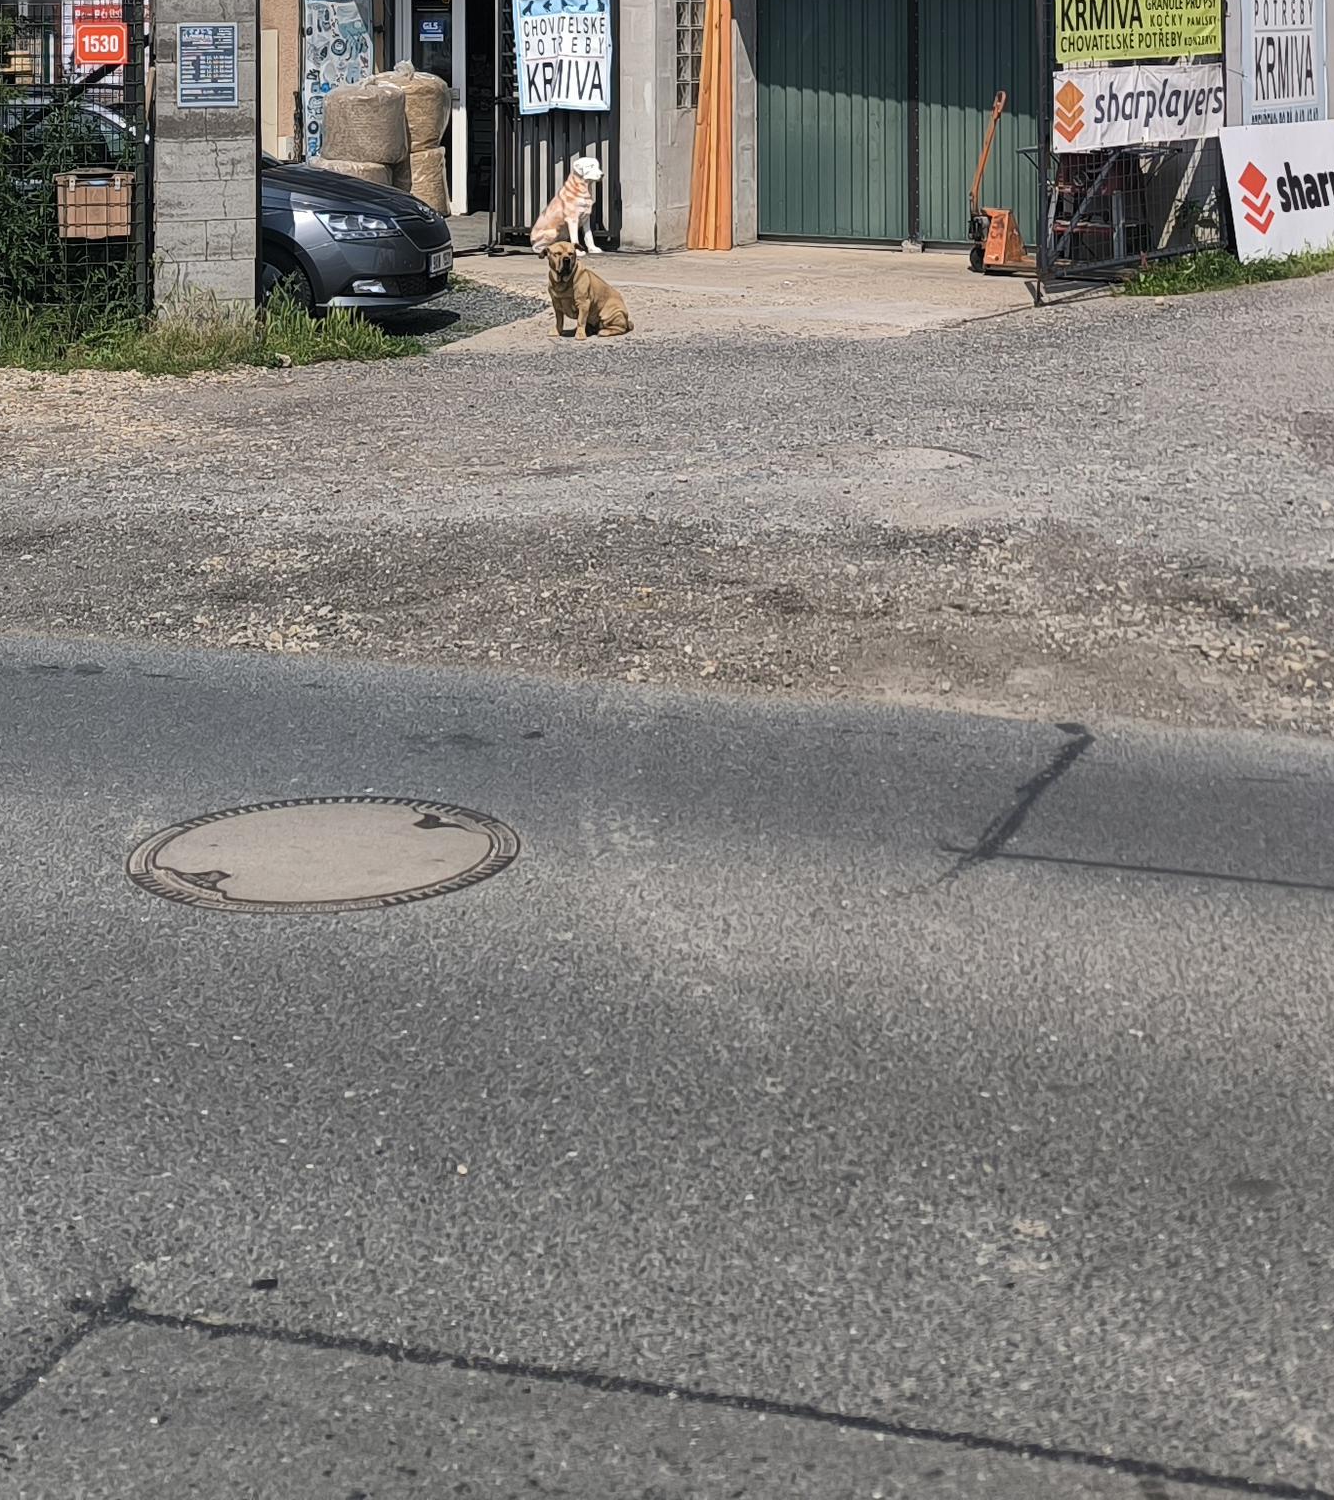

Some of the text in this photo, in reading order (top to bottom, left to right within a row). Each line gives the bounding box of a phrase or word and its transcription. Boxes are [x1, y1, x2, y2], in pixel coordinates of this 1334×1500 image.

[1149, 12, 1217, 27] KOČKY PAMLSKY
[82, 35, 119, 53] 1530
[1060, 29, 1134, 53] CHOVATELSKÉ
[1138, 28, 1183, 49] POTŘEBY
[1255, 35, 1314, 101] KRMIVA
[1094, 78, 1224, 128] sharplayers
